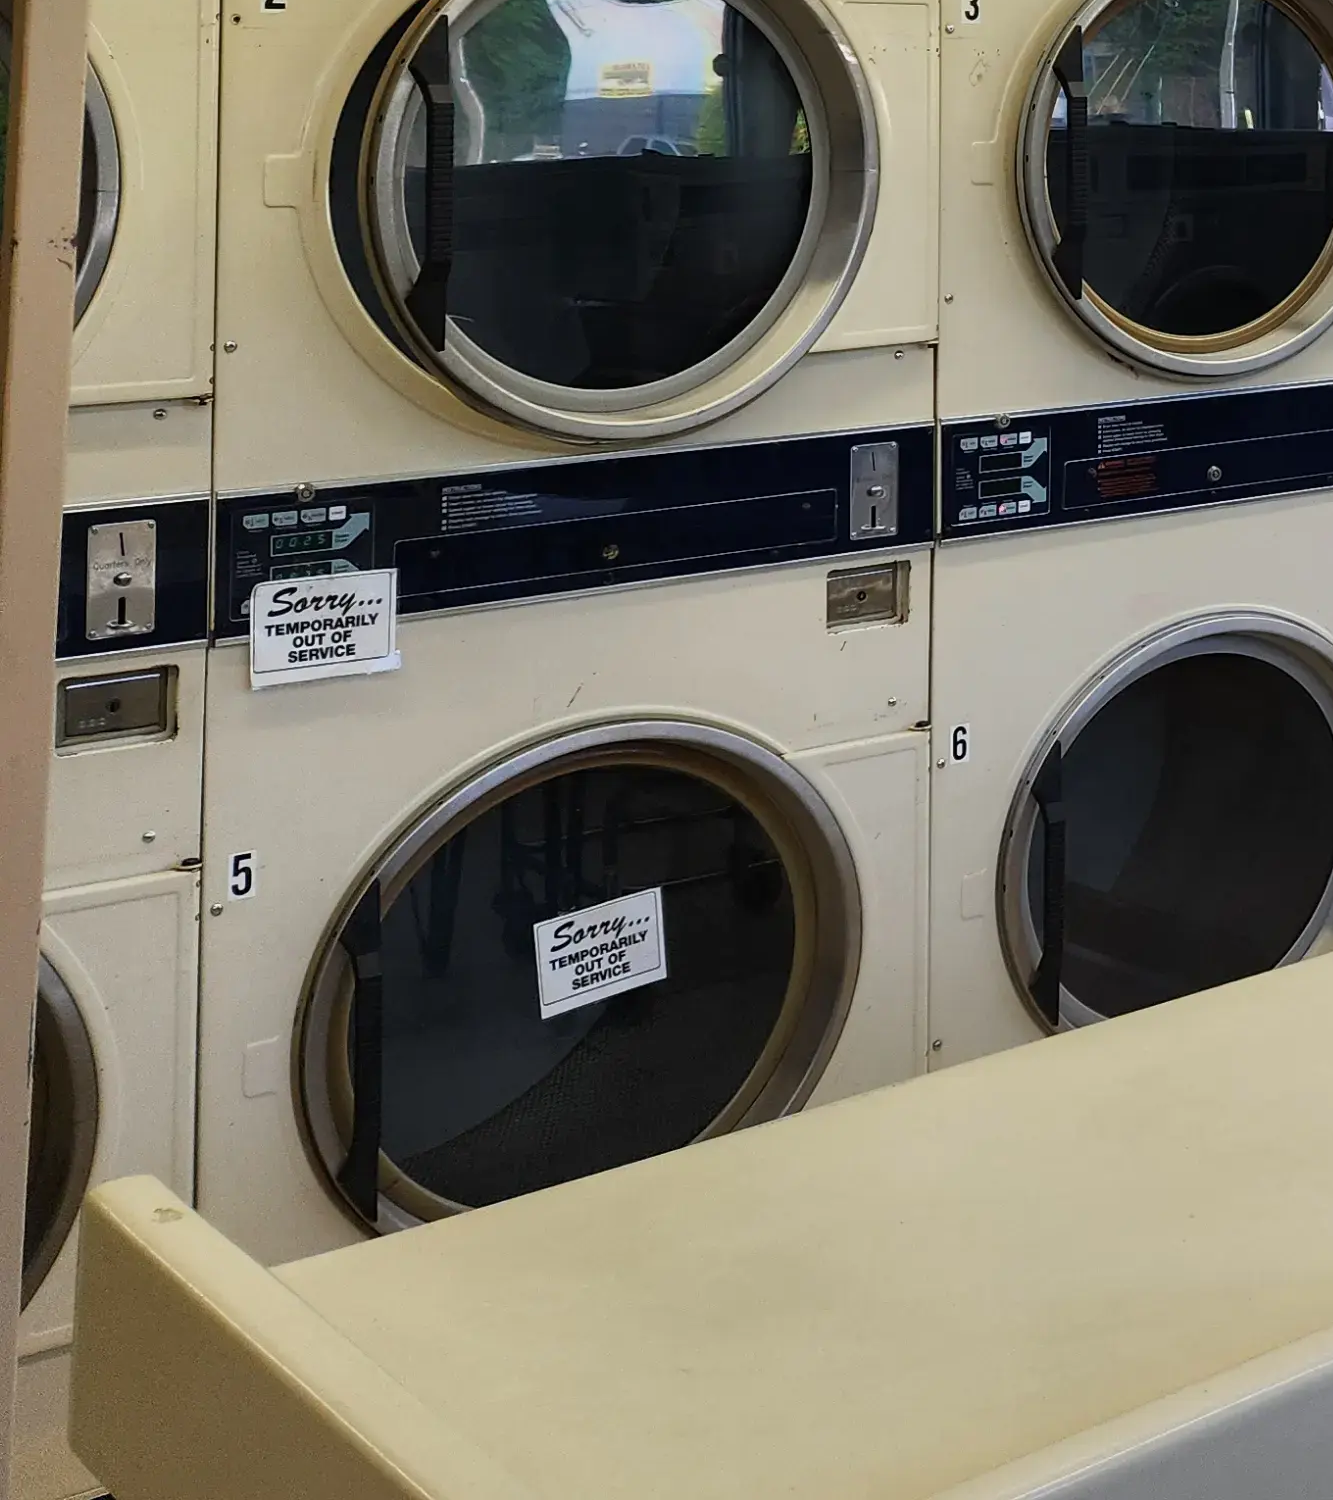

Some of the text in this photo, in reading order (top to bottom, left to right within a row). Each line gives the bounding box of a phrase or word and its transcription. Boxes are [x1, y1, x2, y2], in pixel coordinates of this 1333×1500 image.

[93, 560, 129, 570] Quarters
[267, 587, 382, 617] Sorry...
[264, 613, 379, 637] TEMPORARILY
[293, 630, 352, 648] OUT OF
[288, 643, 356, 663] SERVICE
[952, 725, 967, 761] 6
[231, 852, 252, 896] 5
[550, 916, 650, 952] Sorry...
[549, 930, 648, 971] TEMPORARILY
[575, 950, 627, 976] OUT OF
[572, 961, 631, 990] SERVICE
